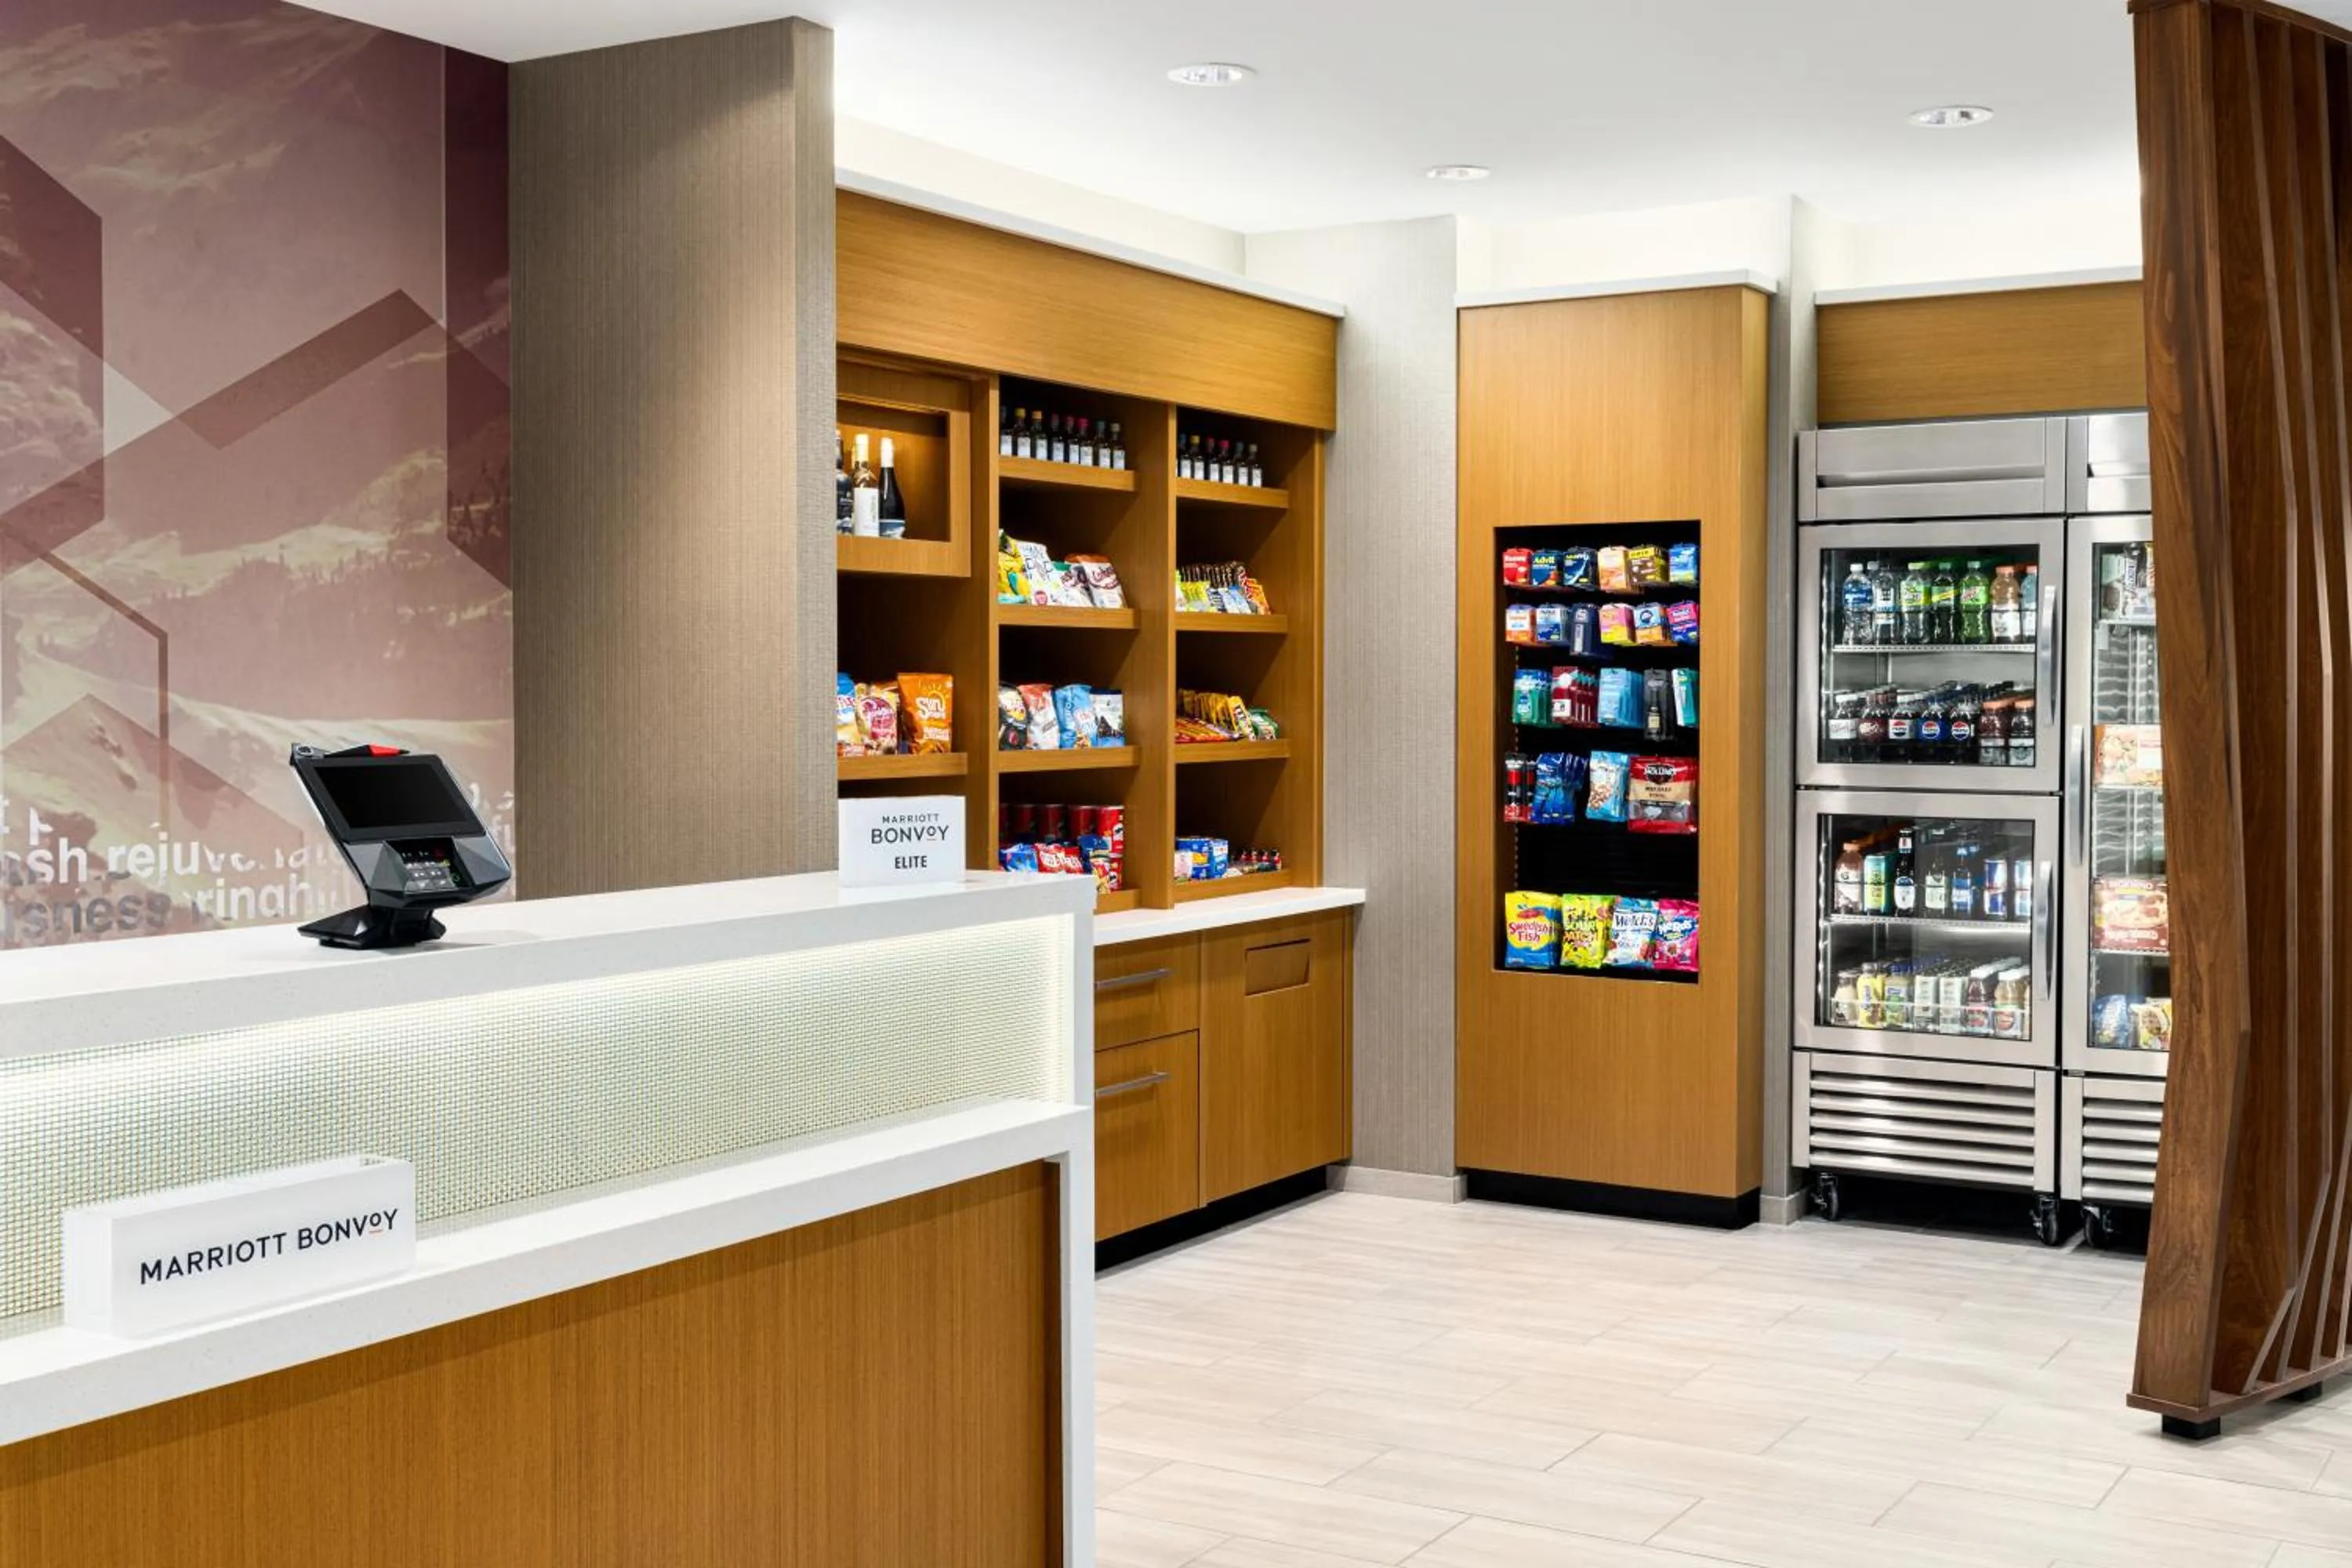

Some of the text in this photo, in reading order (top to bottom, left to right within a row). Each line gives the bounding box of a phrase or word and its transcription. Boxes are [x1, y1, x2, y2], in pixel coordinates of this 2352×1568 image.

[882, 813, 939, 823] MARRIOTT
[871, 825, 949, 844] BONVOY
[895, 855, 927, 869] ELITE
[140, 1208, 398, 1285] MARRIOTT BONVOY
